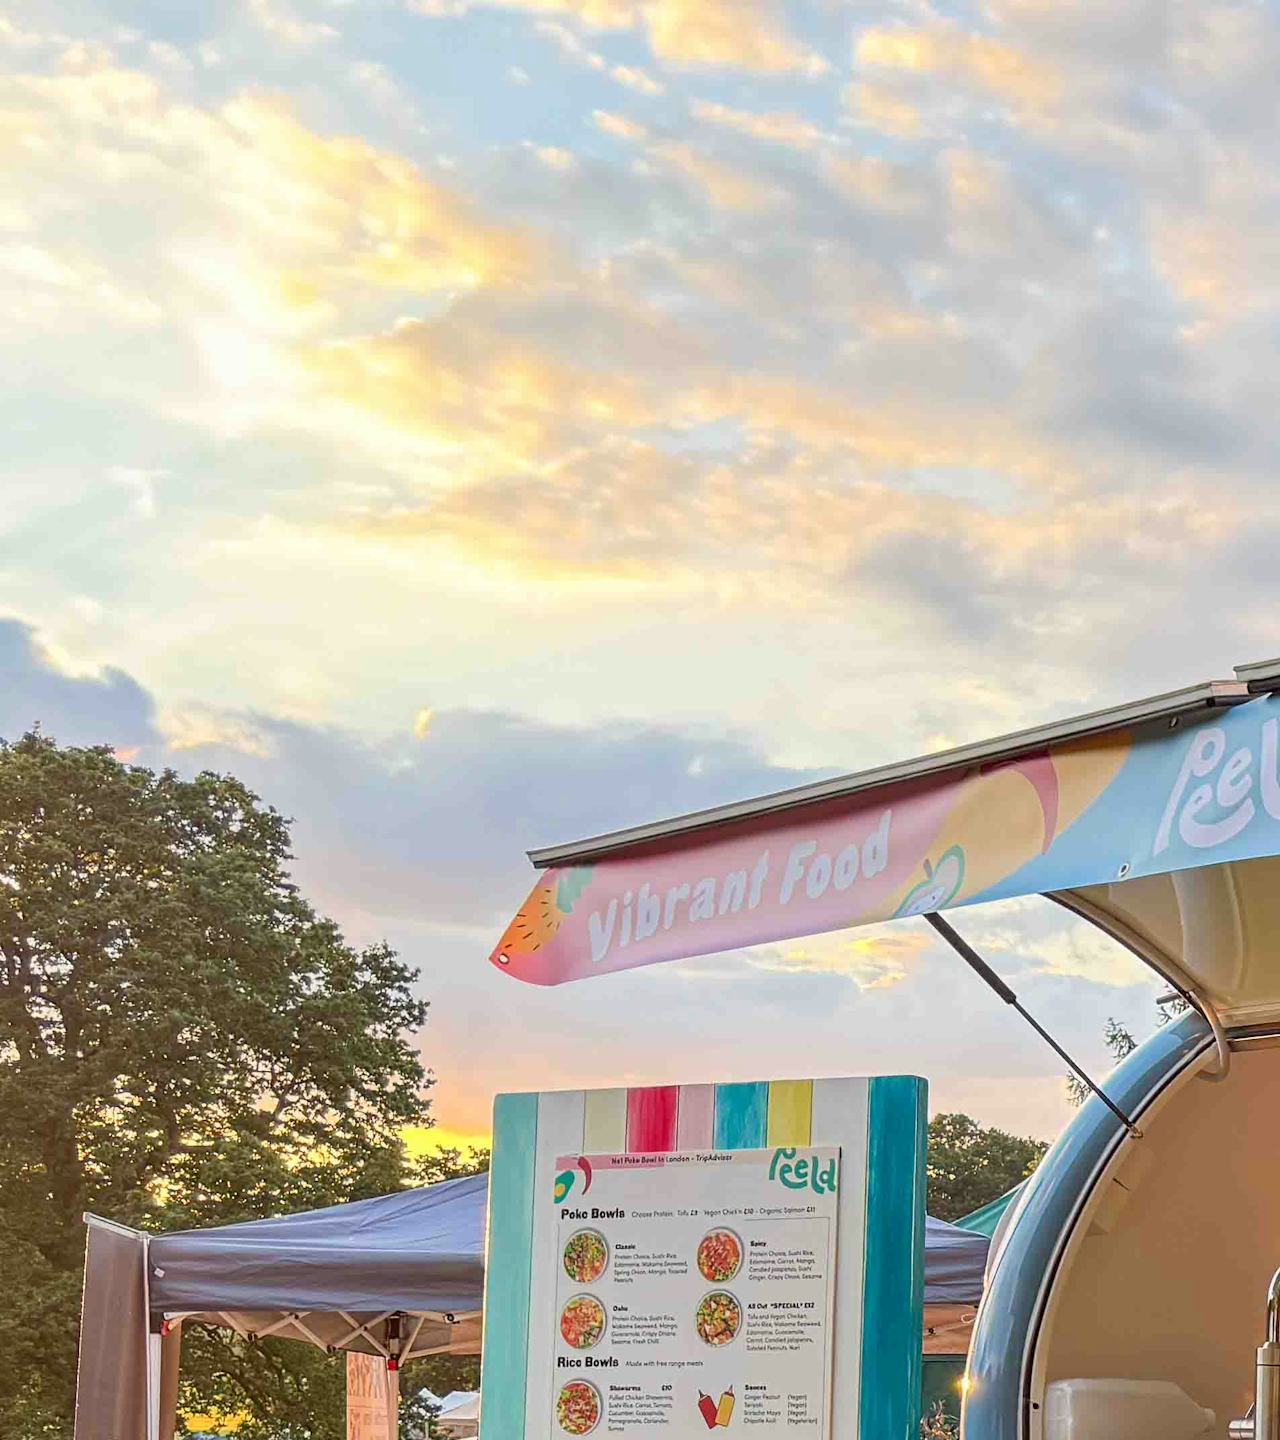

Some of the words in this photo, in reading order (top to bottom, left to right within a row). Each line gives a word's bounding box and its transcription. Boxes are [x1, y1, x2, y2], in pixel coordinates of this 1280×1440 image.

[587, 850, 769, 963] Vibrant
[779, 809, 893, 905] Food
[624, 1156, 640, 1164] Poke
[640, 1155, 657, 1163] Bowl
[665, 1155, 690, 1163] London
[695, 1154, 733, 1162] TripAdvisor
[561, 1208, 588, 1220] Poke
[591, 1207, 625, 1219] Bowls
[750, 1240, 767, 1248] Spicy
[557, 1356, 582, 1368] Rice
[585, 1356, 619, 1368] Bowls
